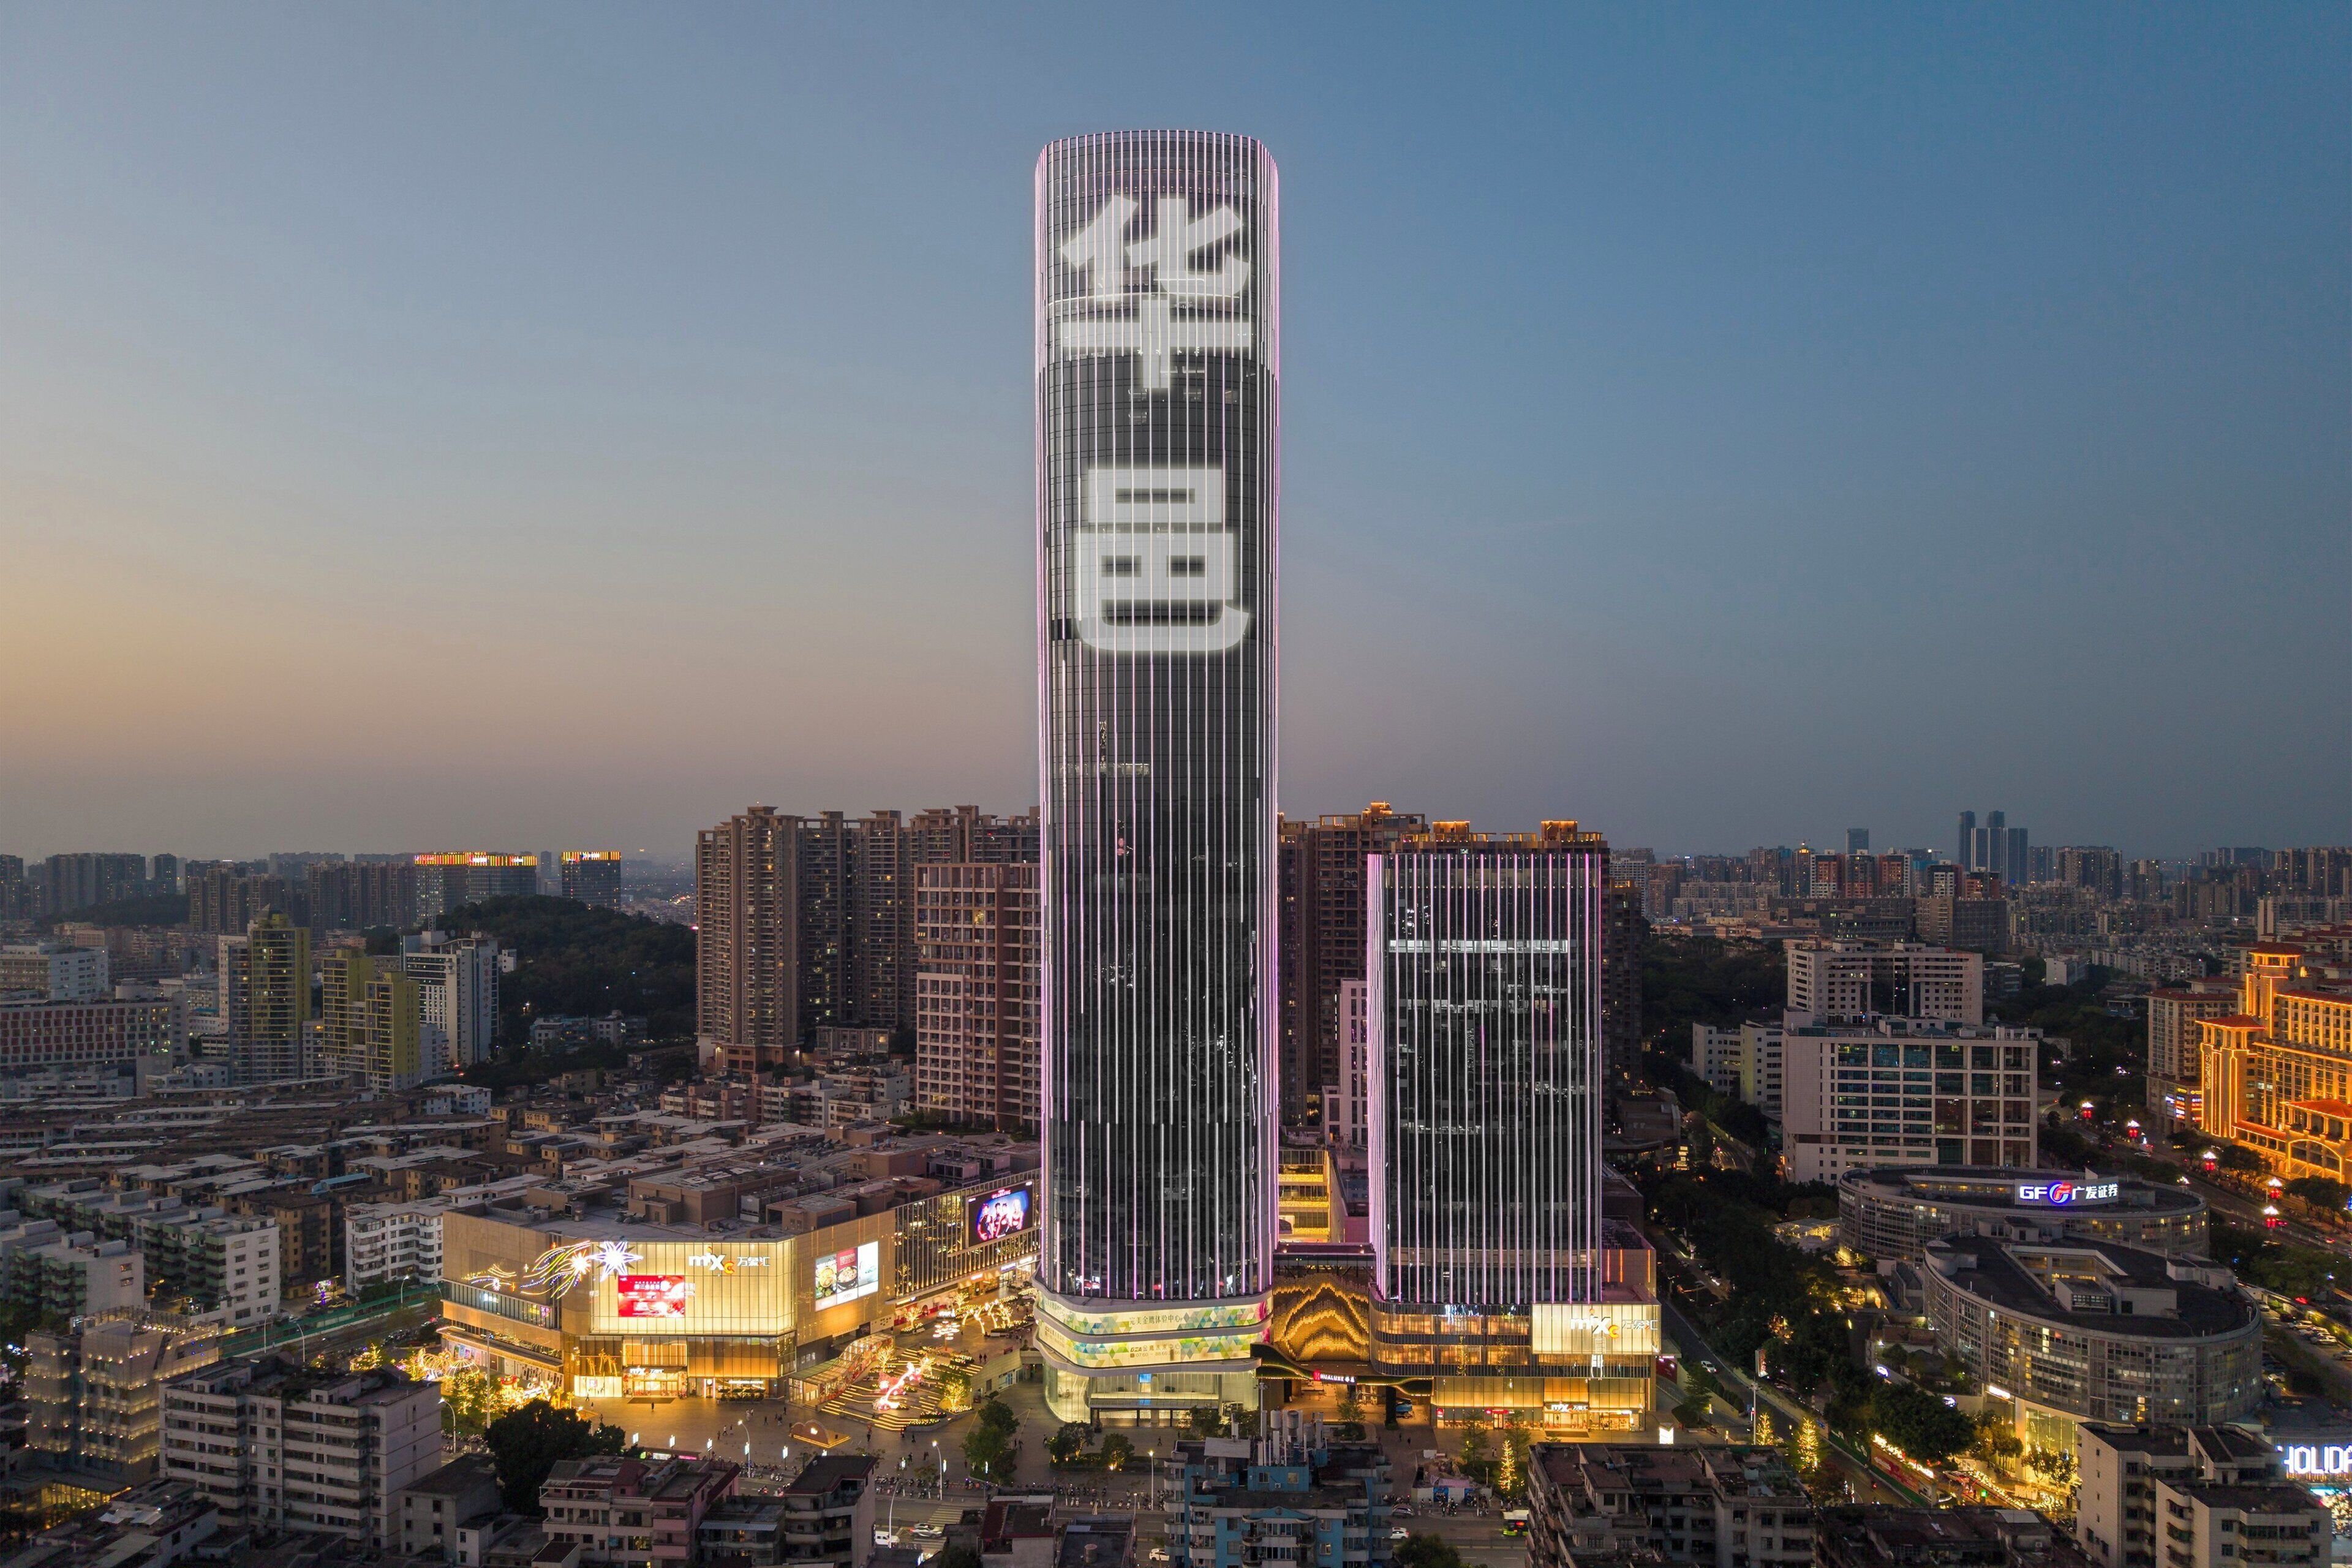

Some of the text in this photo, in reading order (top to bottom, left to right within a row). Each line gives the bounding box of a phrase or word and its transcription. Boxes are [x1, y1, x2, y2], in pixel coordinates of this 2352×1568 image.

[2019, 1183, 2119, 1200] GF 广发证券
[1623, 1319, 1658, 1330] 万象汇
